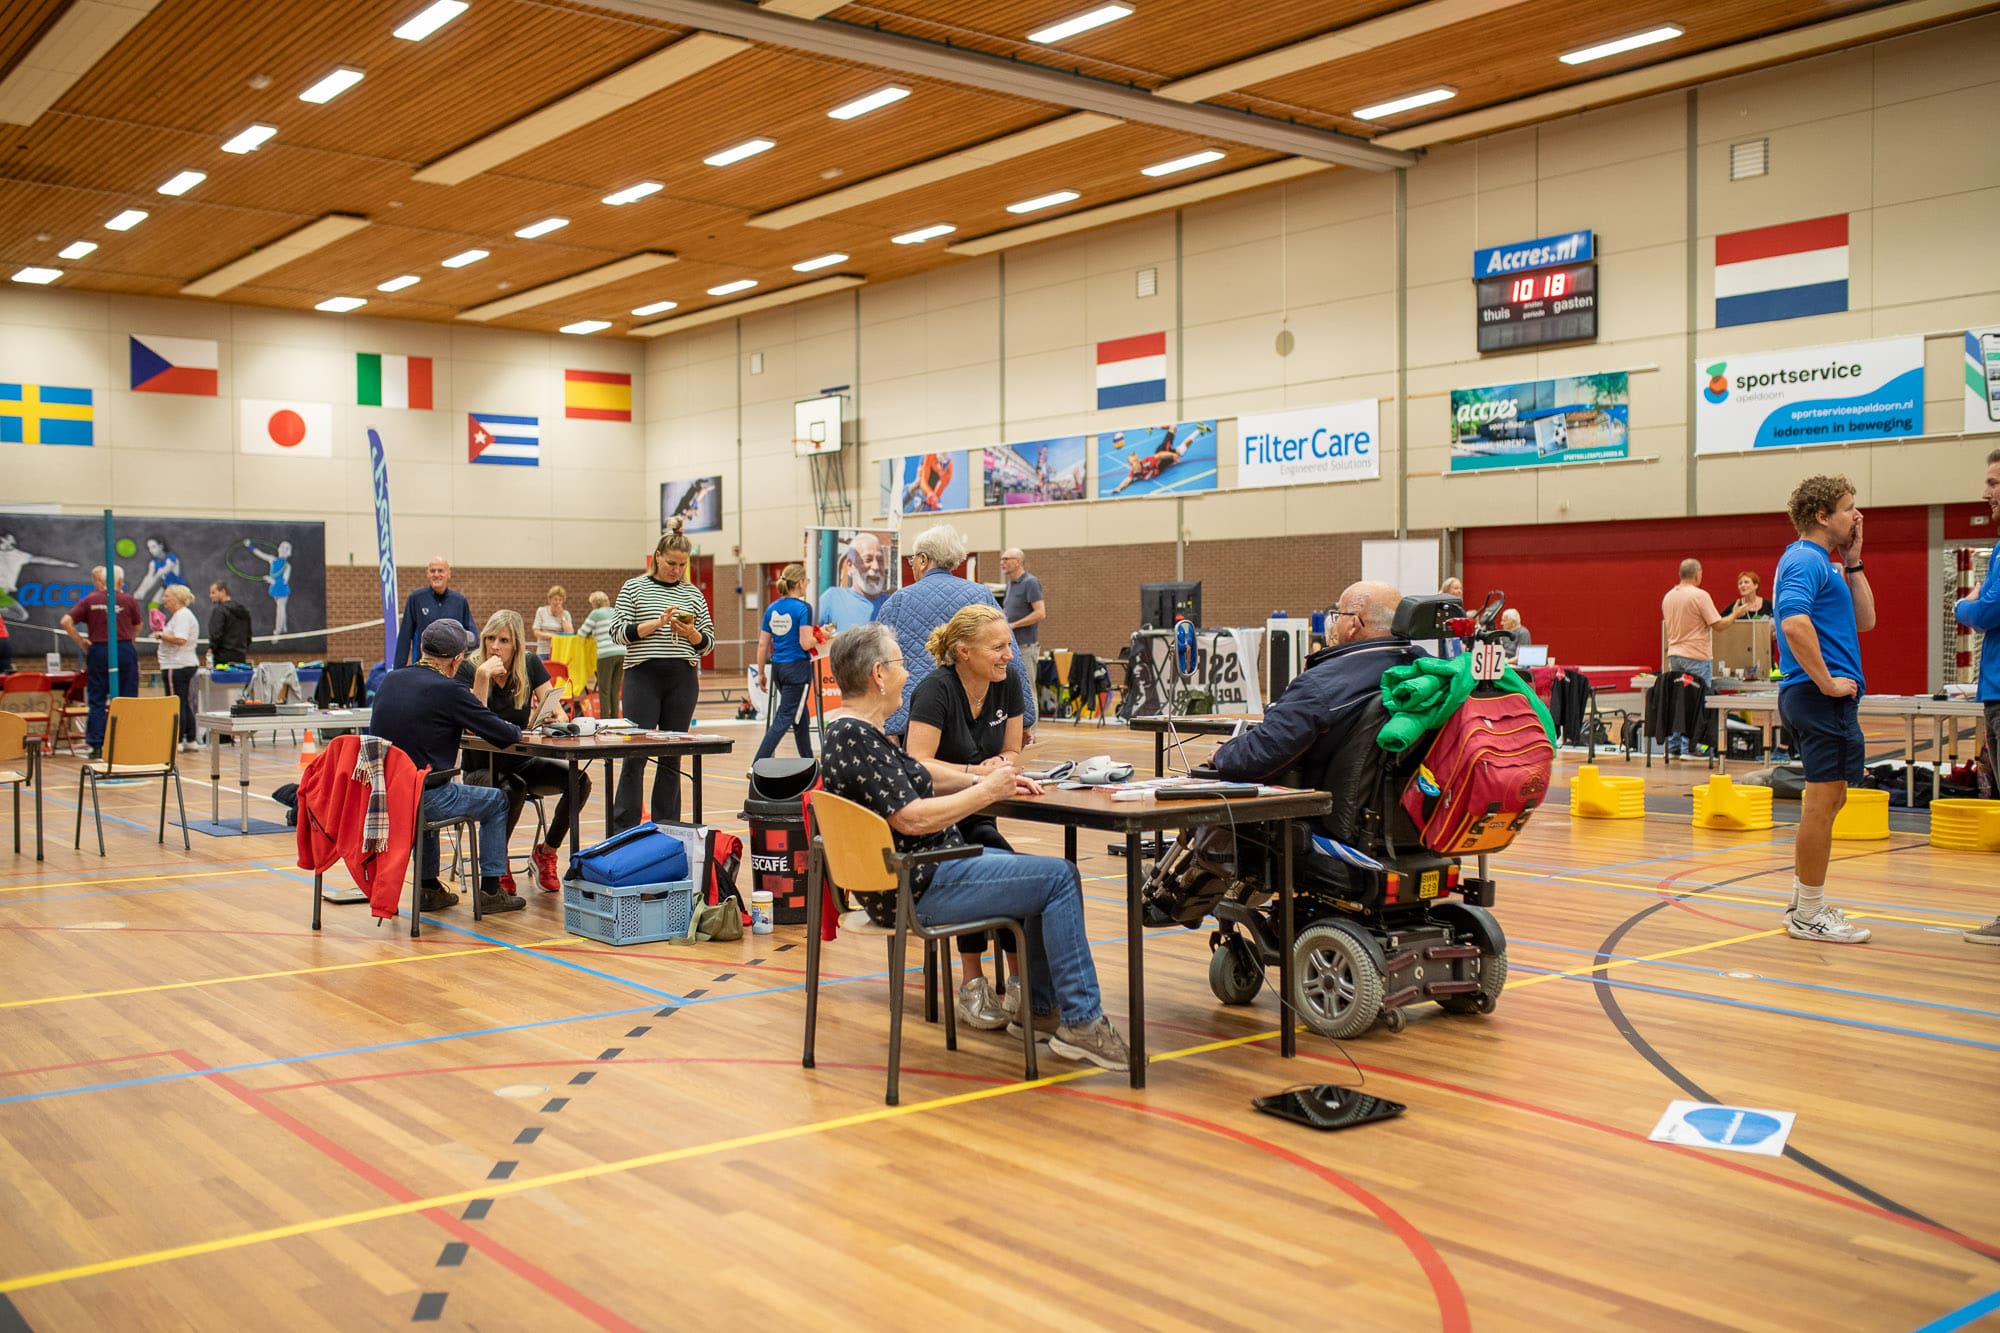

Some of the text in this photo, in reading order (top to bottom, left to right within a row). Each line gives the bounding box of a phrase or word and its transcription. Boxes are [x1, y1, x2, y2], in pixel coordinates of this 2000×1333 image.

[1487, 234, 1579, 273] Accres.nl
[1512, 273, 1566, 303] 10 18
[1483, 307, 1511, 322] thuis
[1553, 296, 1593, 314] gasten
[1736, 361, 1863, 392] sportservice
[1736, 391, 1785, 404] apeldoorn
[1457, 398, 1518, 423] accres
[1791, 400, 1914, 419] sportserviceapeldoorn.nl
[1773, 416, 1913, 438] iedereen in beweging
[1280, 459, 1372, 476] Engineered Solutions
